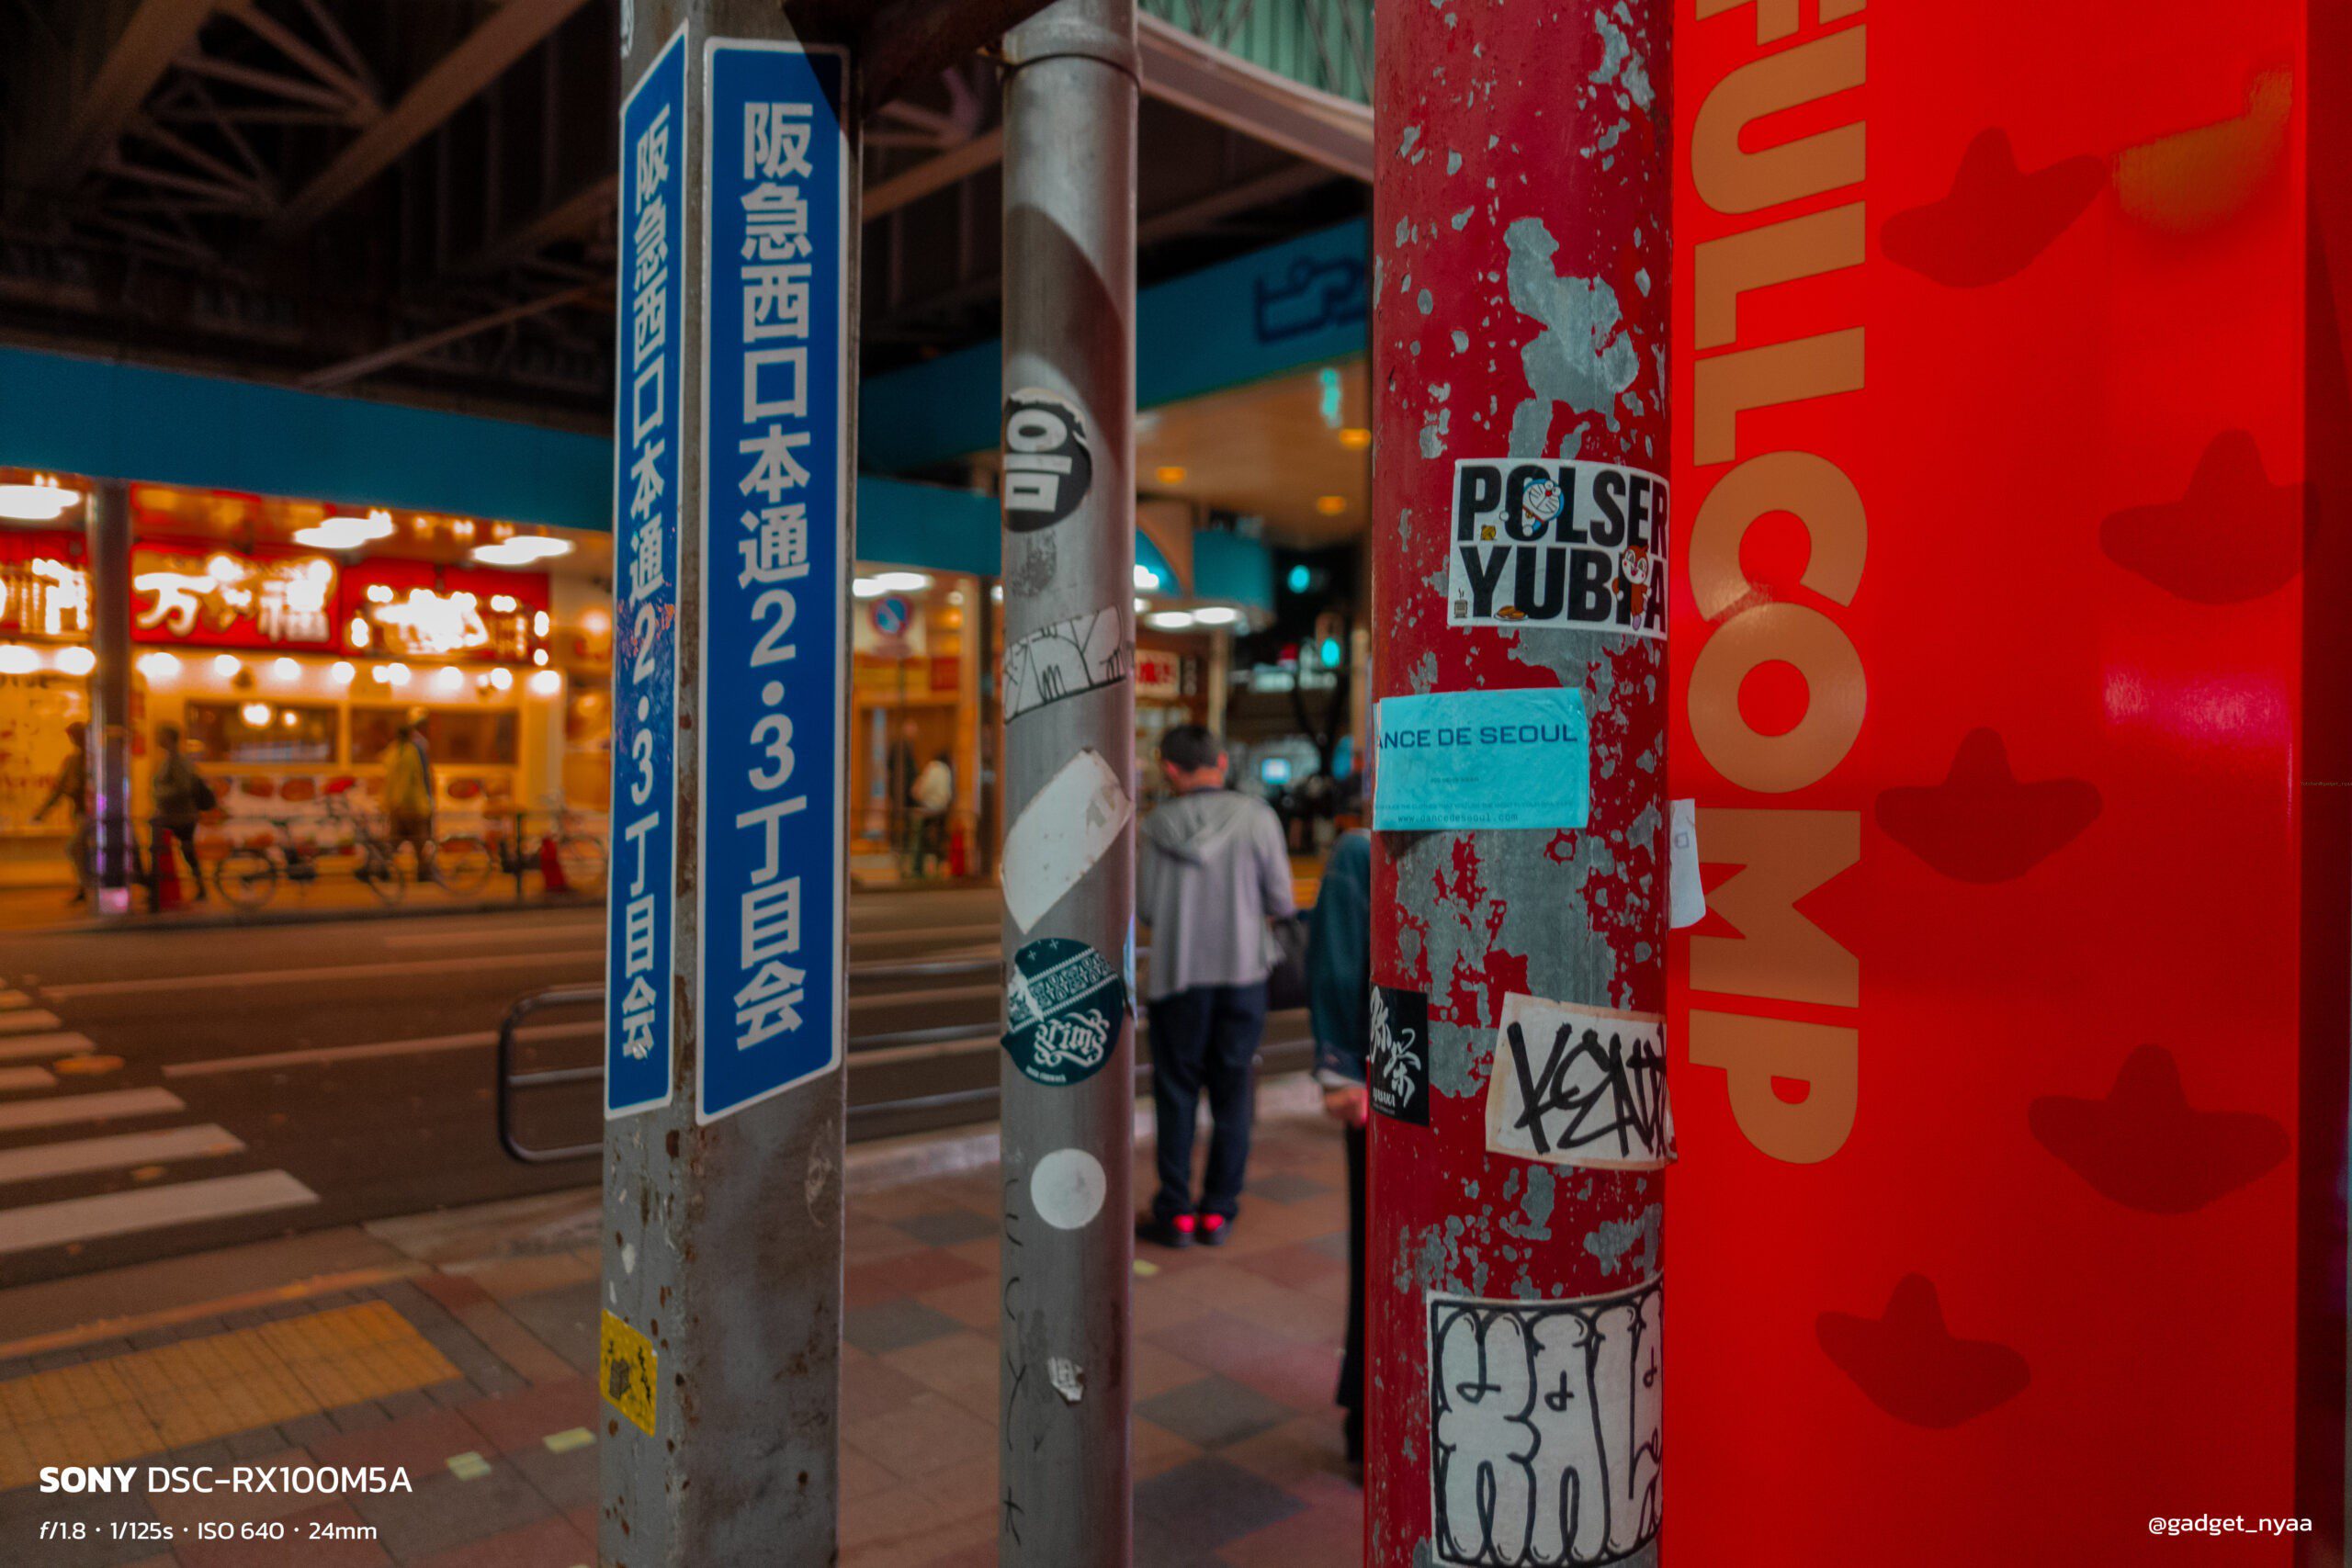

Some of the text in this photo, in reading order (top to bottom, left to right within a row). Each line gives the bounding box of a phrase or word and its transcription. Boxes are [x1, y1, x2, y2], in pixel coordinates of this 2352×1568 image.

[1457, 465, 1668, 559] POLSER
[1689, 0, 1868, 1165] ULLCOMP
[1438, 728, 1472, 746] DE
[1479, 724, 1578, 744] SEOUL
